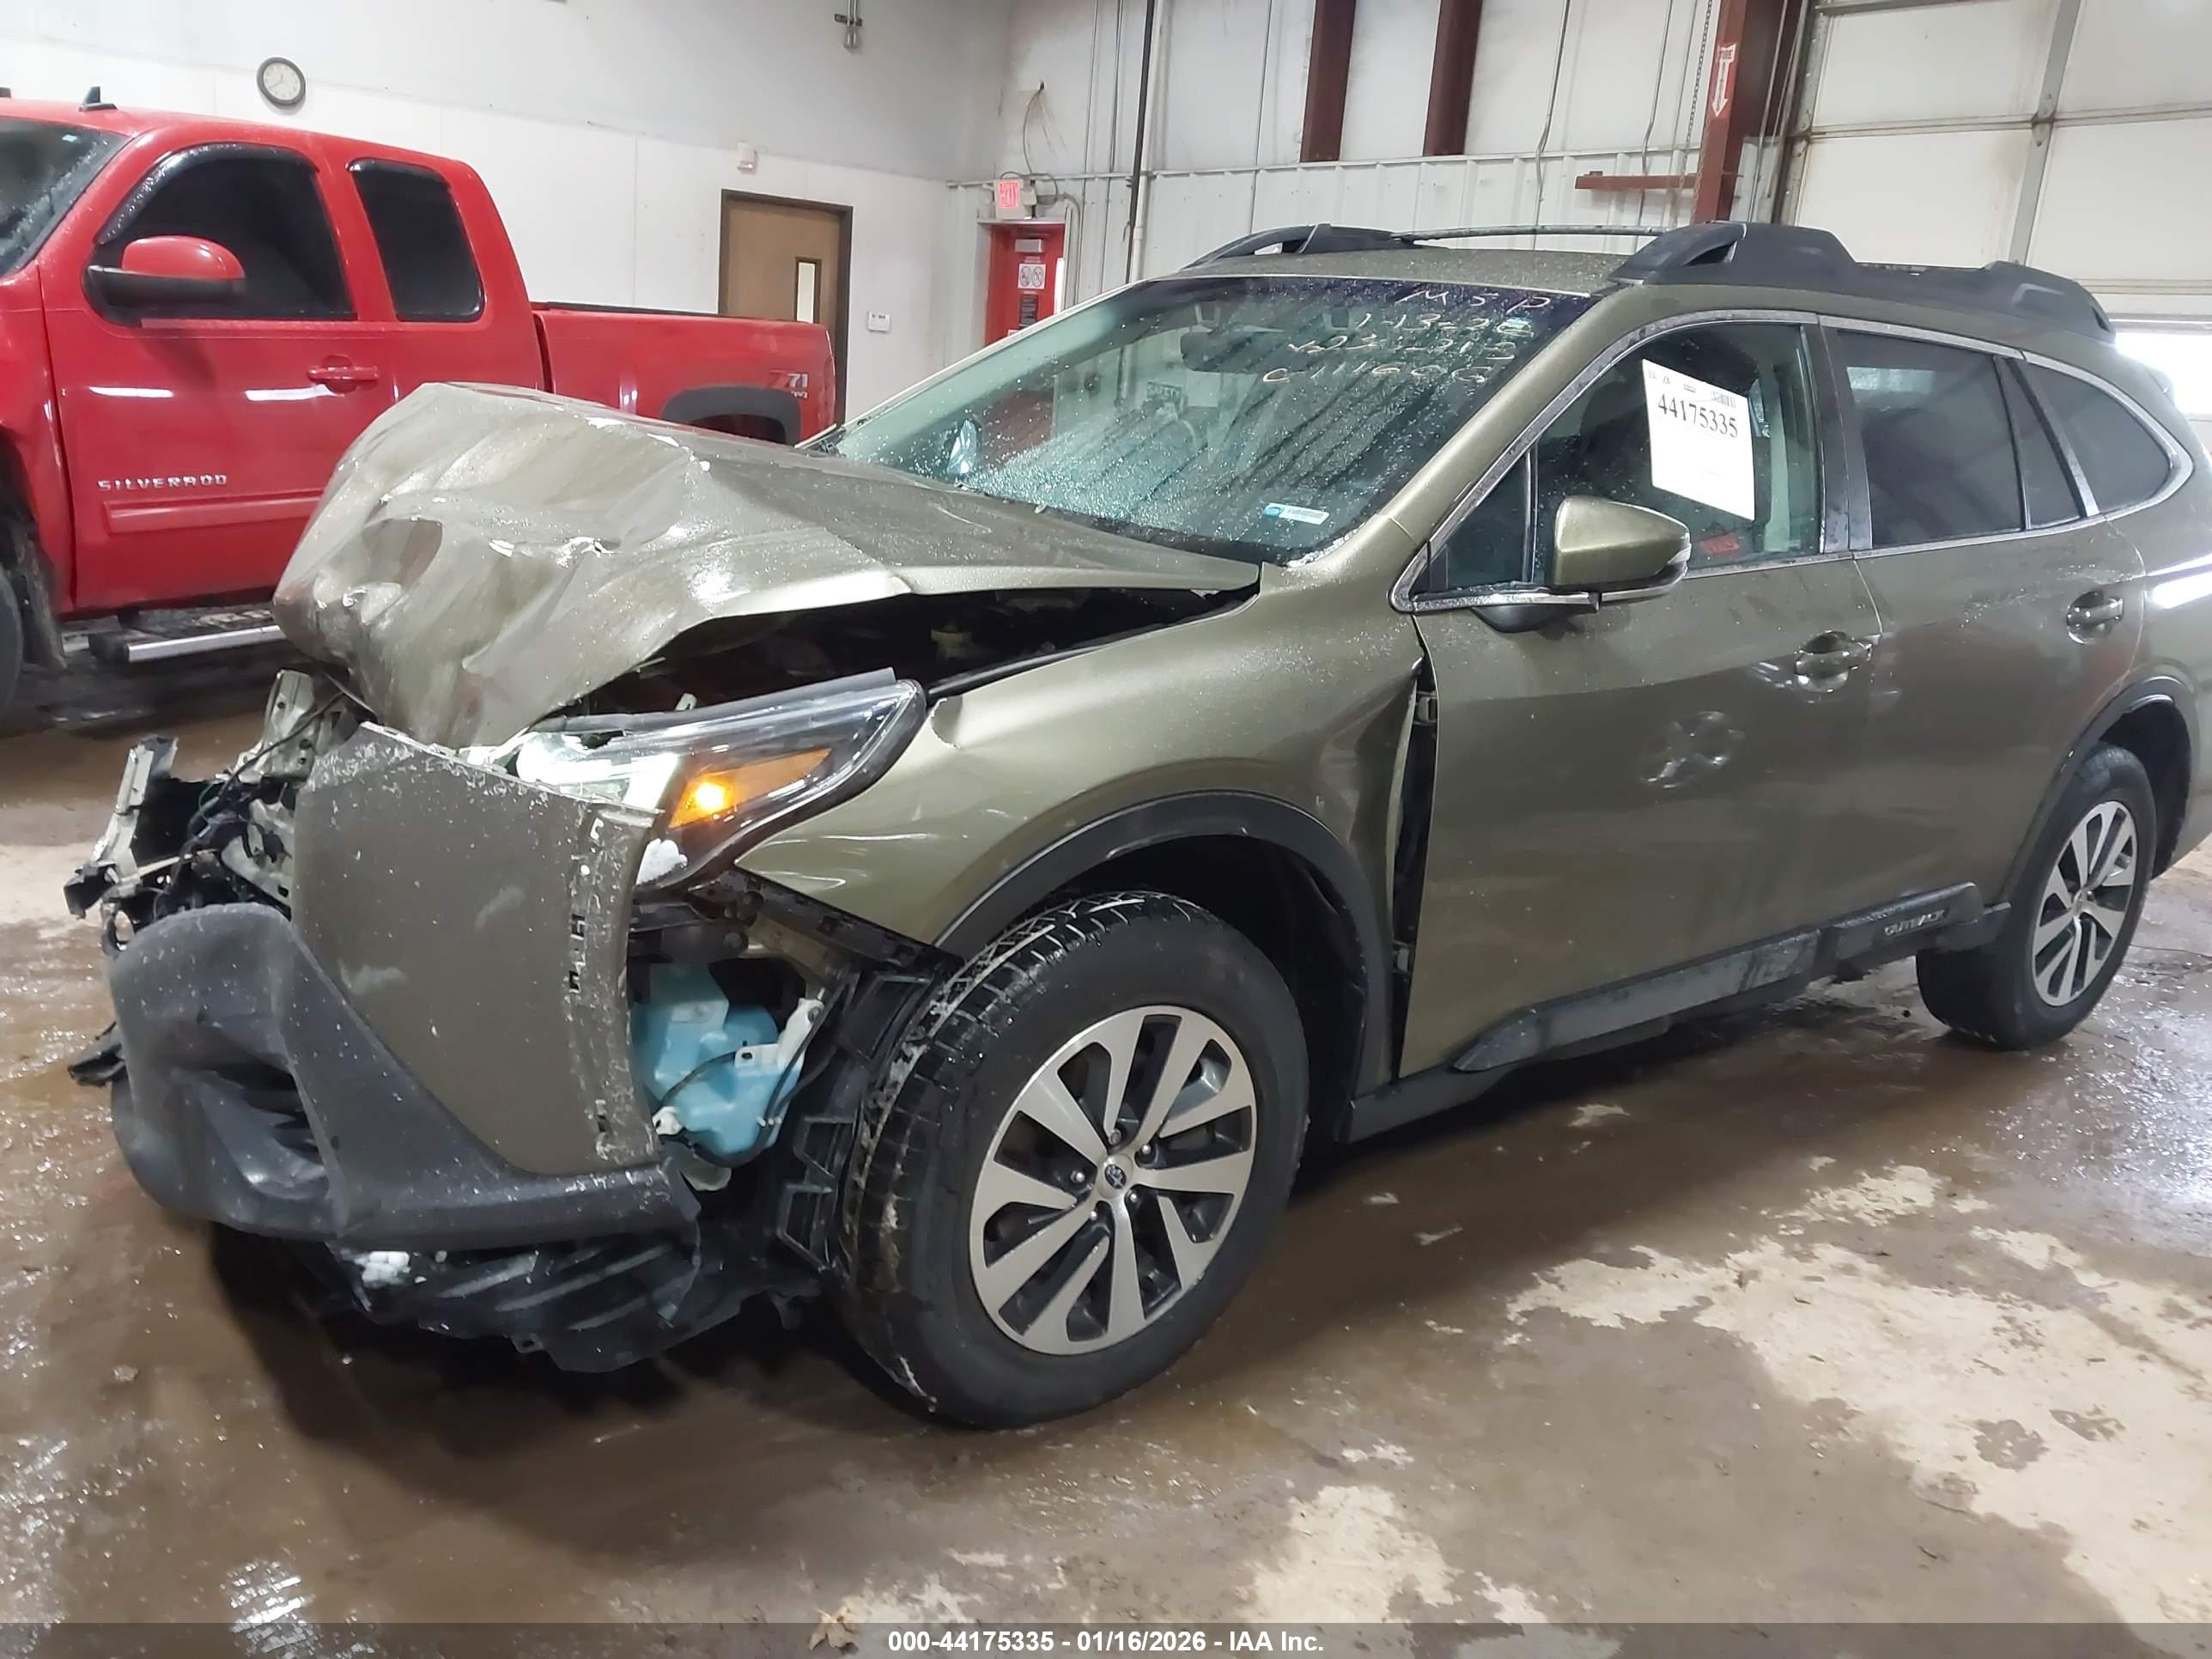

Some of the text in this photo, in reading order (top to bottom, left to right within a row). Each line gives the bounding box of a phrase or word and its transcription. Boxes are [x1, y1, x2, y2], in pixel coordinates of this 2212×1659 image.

[1658, 393, 1738, 438] 44175335
[97, 474, 228, 491] SILVERADO
[1884, 910, 1947, 936] OUTBACK
